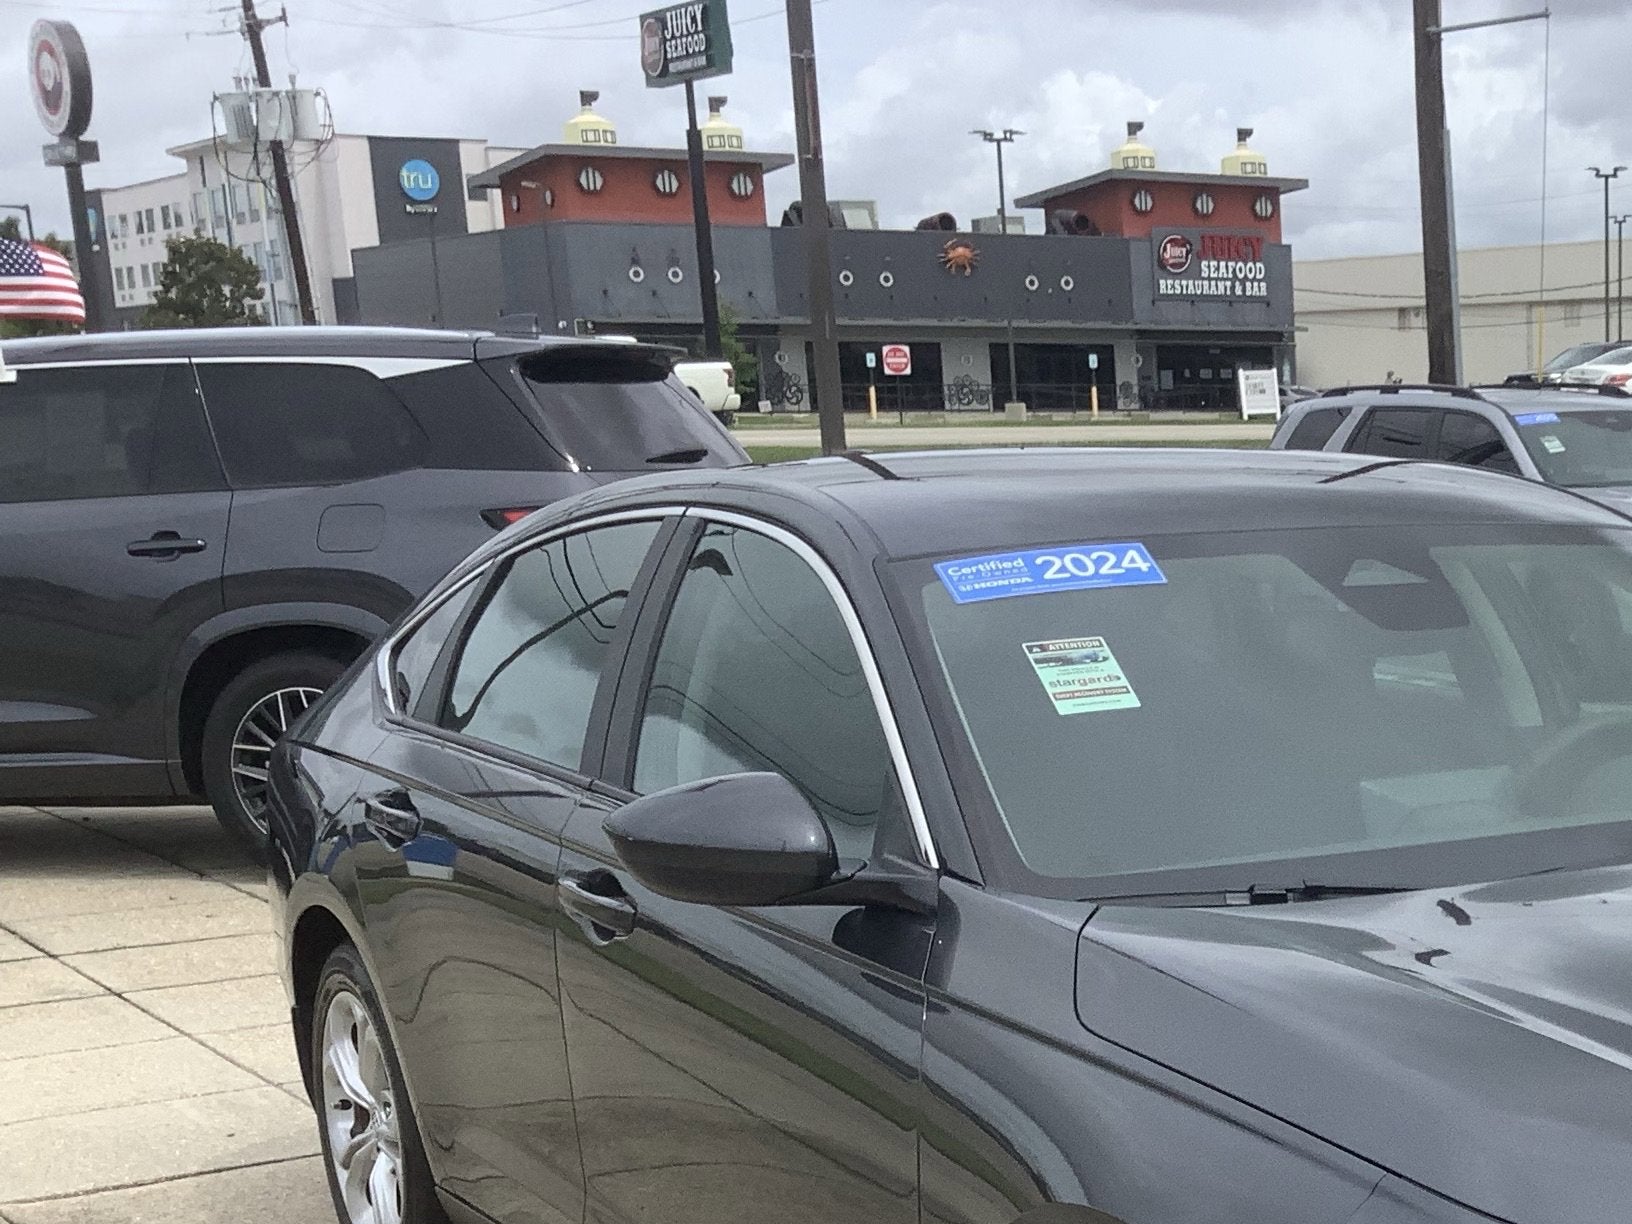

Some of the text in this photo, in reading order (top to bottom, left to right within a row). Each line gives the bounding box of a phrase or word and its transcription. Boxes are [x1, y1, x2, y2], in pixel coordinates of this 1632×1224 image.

[664, 3, 703, 40] JUICY
[665, 33, 706, 59] SEAFOOD
[400, 168, 432, 188] tru
[1197, 234, 1263, 261] JUICY
[1201, 260, 1266, 279] SEAFOOD
[1160, 279, 1268, 296] RESTAURANT & BAR
[948, 549, 1151, 580] Certified 2024
[973, 577, 1033, 589] HONDA
[1049, 640, 1100, 651] ATTENTION
